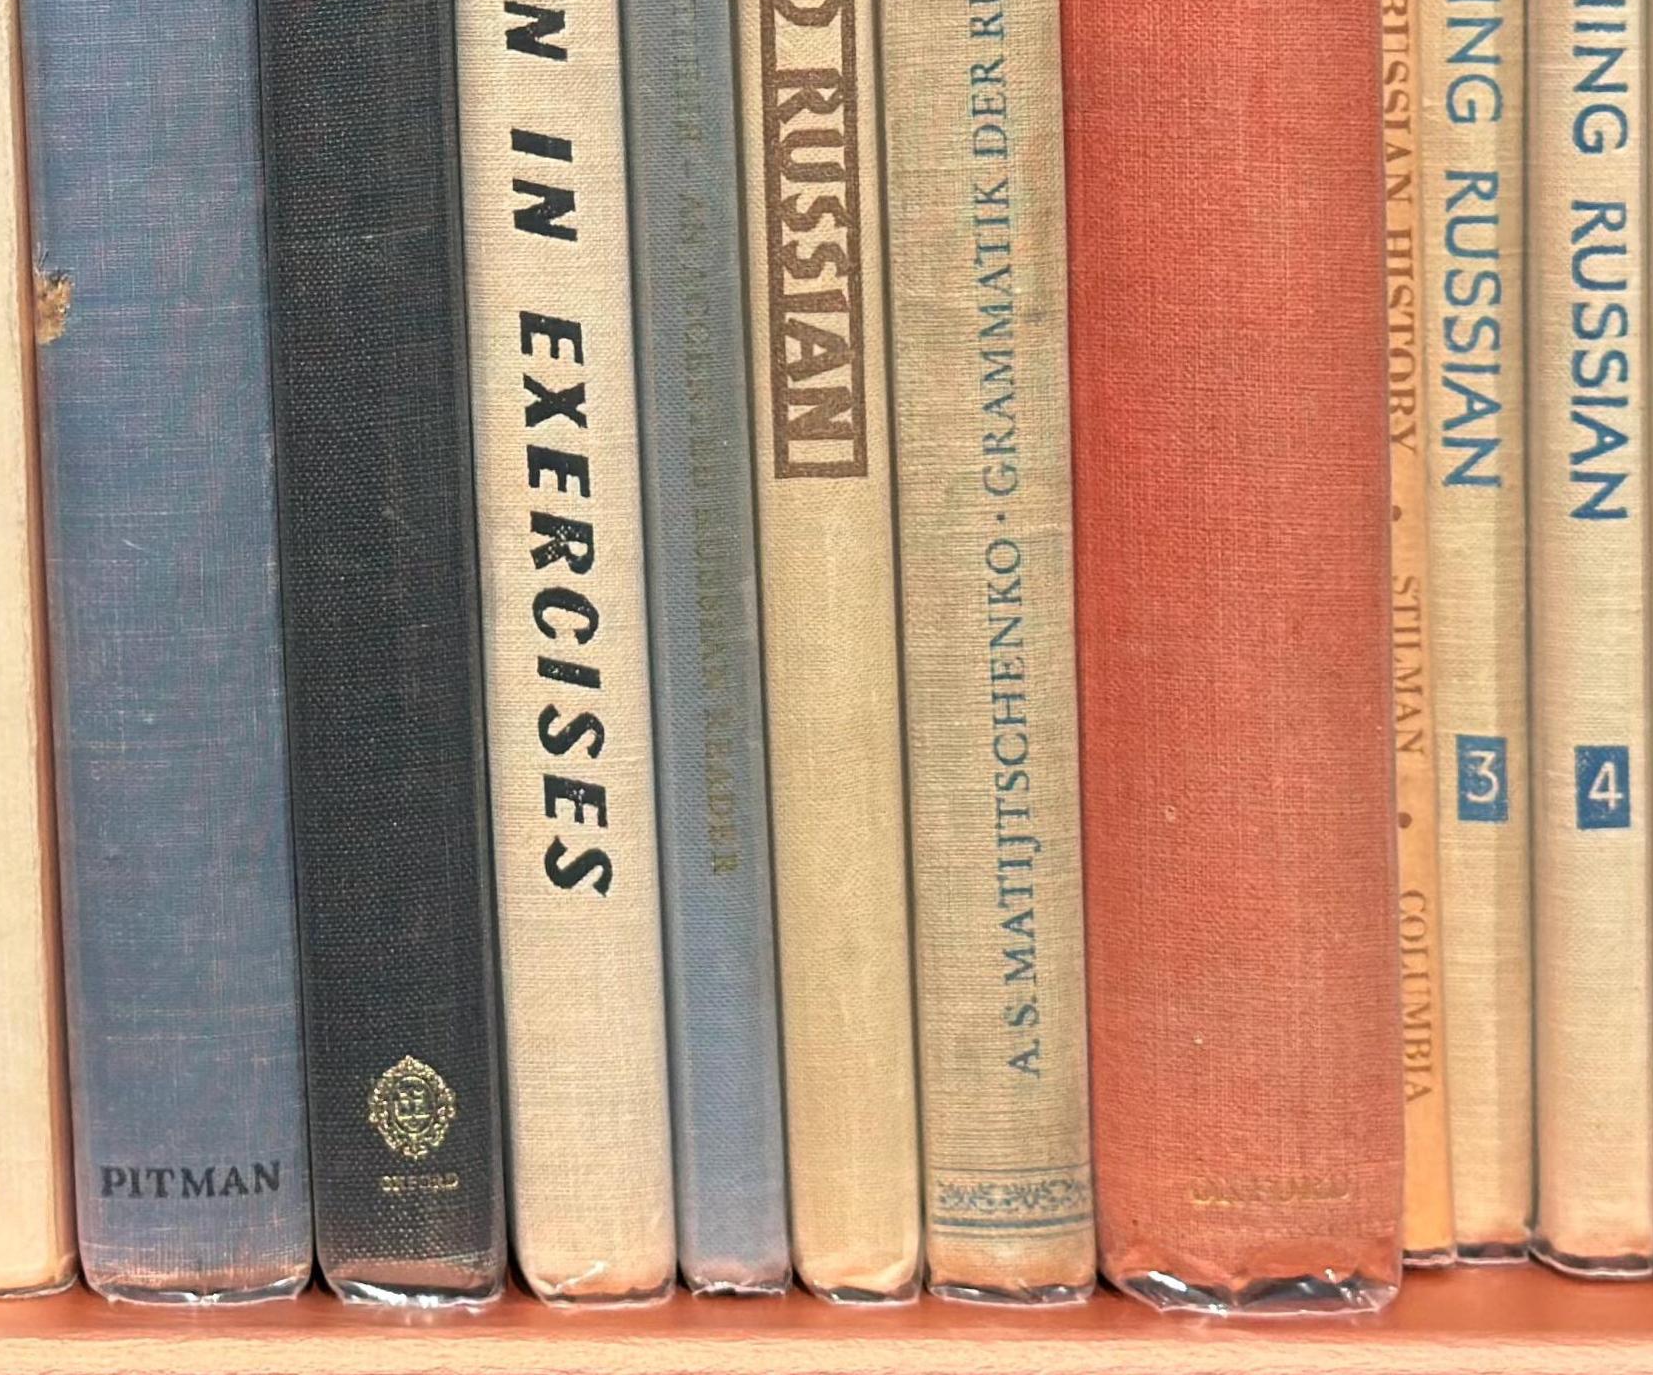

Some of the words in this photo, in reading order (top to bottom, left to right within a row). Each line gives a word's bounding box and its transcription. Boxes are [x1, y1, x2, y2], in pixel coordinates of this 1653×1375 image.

[509, 127, 580, 244] IN
[969, 60, 1007, 162] DER
[773, 67, 856, 444] RUSSIAN
[971, 175, 1017, 498] GRAMMATIK
[1386, 227, 1418, 455] HISTORY
[1442, 169, 1503, 488] RUSSIAN
[1568, 199, 1629, 522] RUSSIAN
[519, 309, 615, 899] EXERCISES
[1393, 575, 1428, 756] STILMAN
[985, 536, 1044, 985] MATIJTSCHENKO
[1466, 750, 1499, 804] 3
[1586, 759, 1625, 808] 4
[1002, 990, 1039, 1031] S.
[1005, 1037, 1041, 1079] A.
[1397, 889, 1433, 1104] COLUMBIA
[100, 1159, 283, 1201] PITMAN
